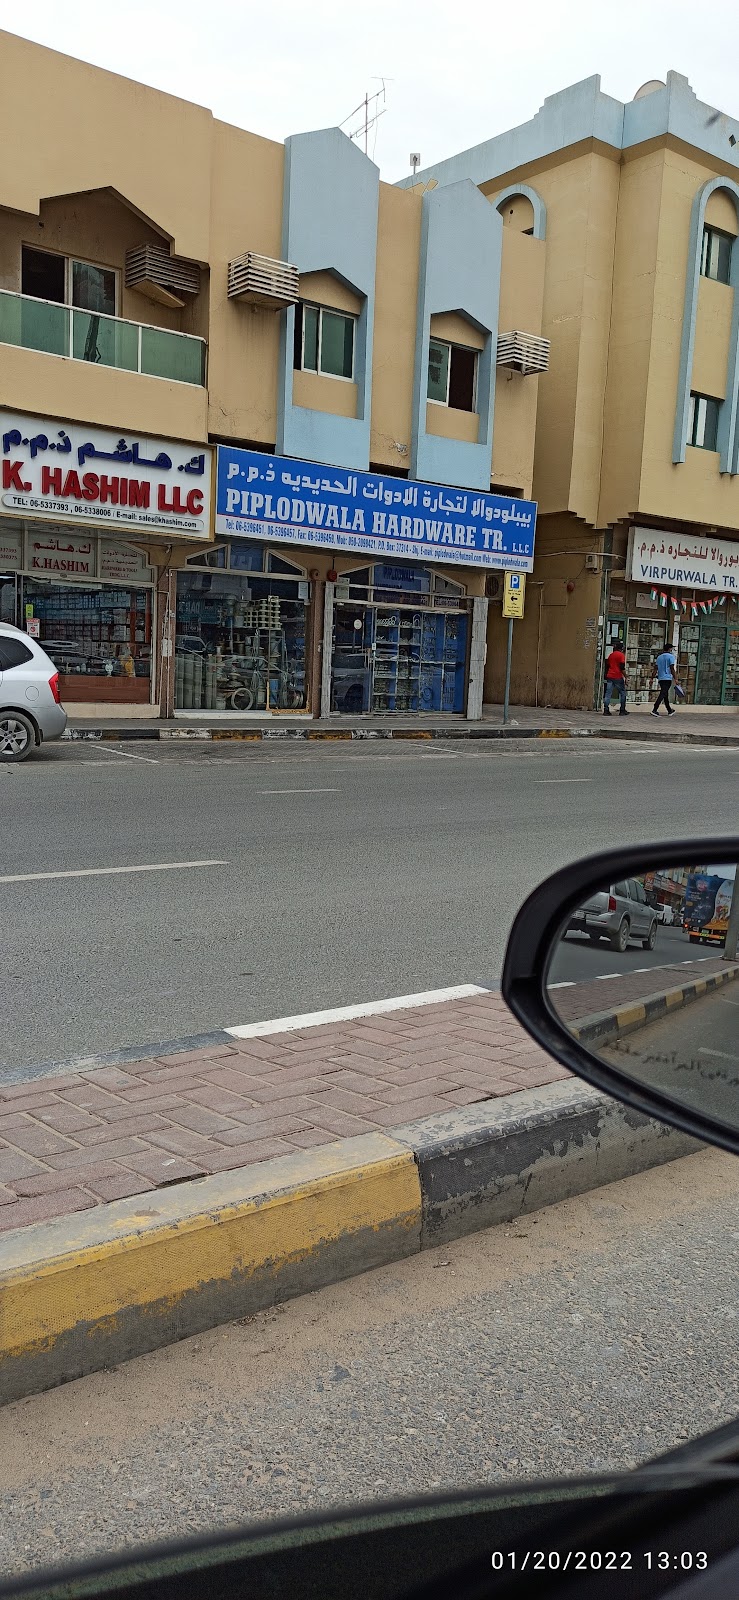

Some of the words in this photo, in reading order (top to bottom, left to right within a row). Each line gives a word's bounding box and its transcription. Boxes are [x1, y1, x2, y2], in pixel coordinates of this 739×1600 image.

[77, 438, 173, 467] هاشم
[2, 459, 33, 492] K.
[41, 465, 151, 509] HASHIM
[157, 483, 204, 516] LLC
[362, 481, 418, 507] الادوات
[12, 496, 28, 507] TEL:
[29, 499, 69, 512] 06-5337393
[116, 510, 138, 521] E-mail:
[138, 514, 197, 529] sales@khashim.com
[422, 490, 468, 516] لتجارة
[225, 488, 366, 532] PIPLODWALA
[371, 511, 477, 547] HARDWARE
[481, 527, 507, 551] TR.
[640, 564, 717, 586] VIRPURWALA
[722, 575, 738, 588] TR.
